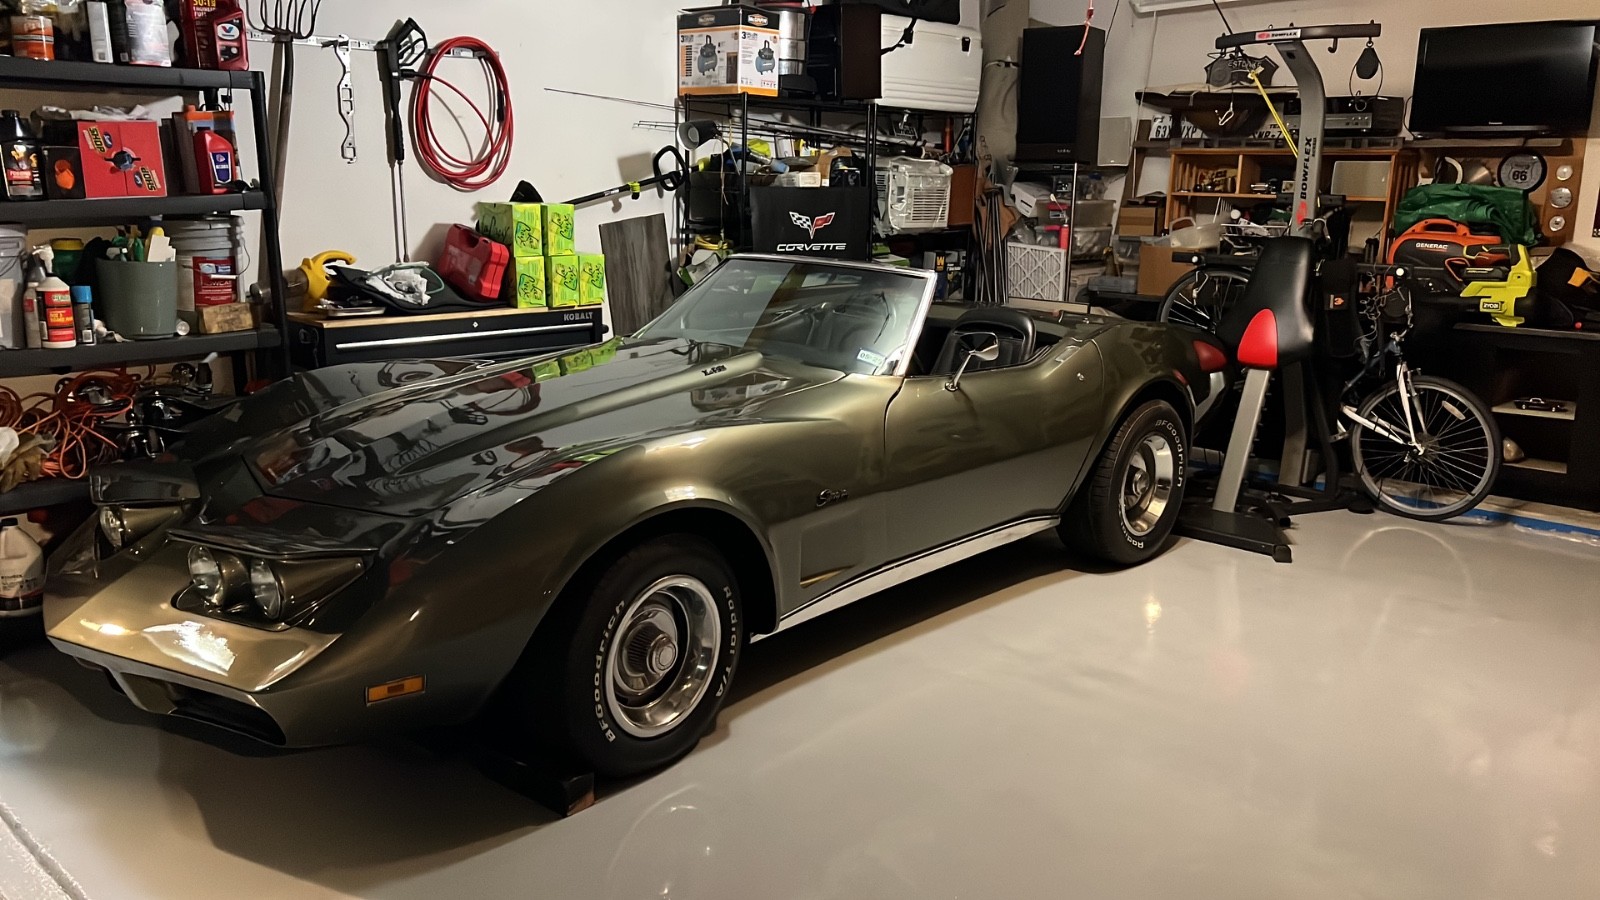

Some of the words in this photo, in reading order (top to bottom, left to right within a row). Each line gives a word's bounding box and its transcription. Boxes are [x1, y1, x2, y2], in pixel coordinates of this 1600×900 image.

[88, 126, 106, 153] SHOP
[140, 167, 157, 191] SHOP
[1300, 136, 1313, 200] BOWFLEX
[776, 242, 847, 252] CORVETTE
[1415, 242, 1449, 250] GENERAC
[563, 311, 593, 321] KOBALT
[1483, 302, 1499, 310] RYOBI
[594, 600, 625, 743] BFGoodrich
[715, 666, 733, 697] T/A
